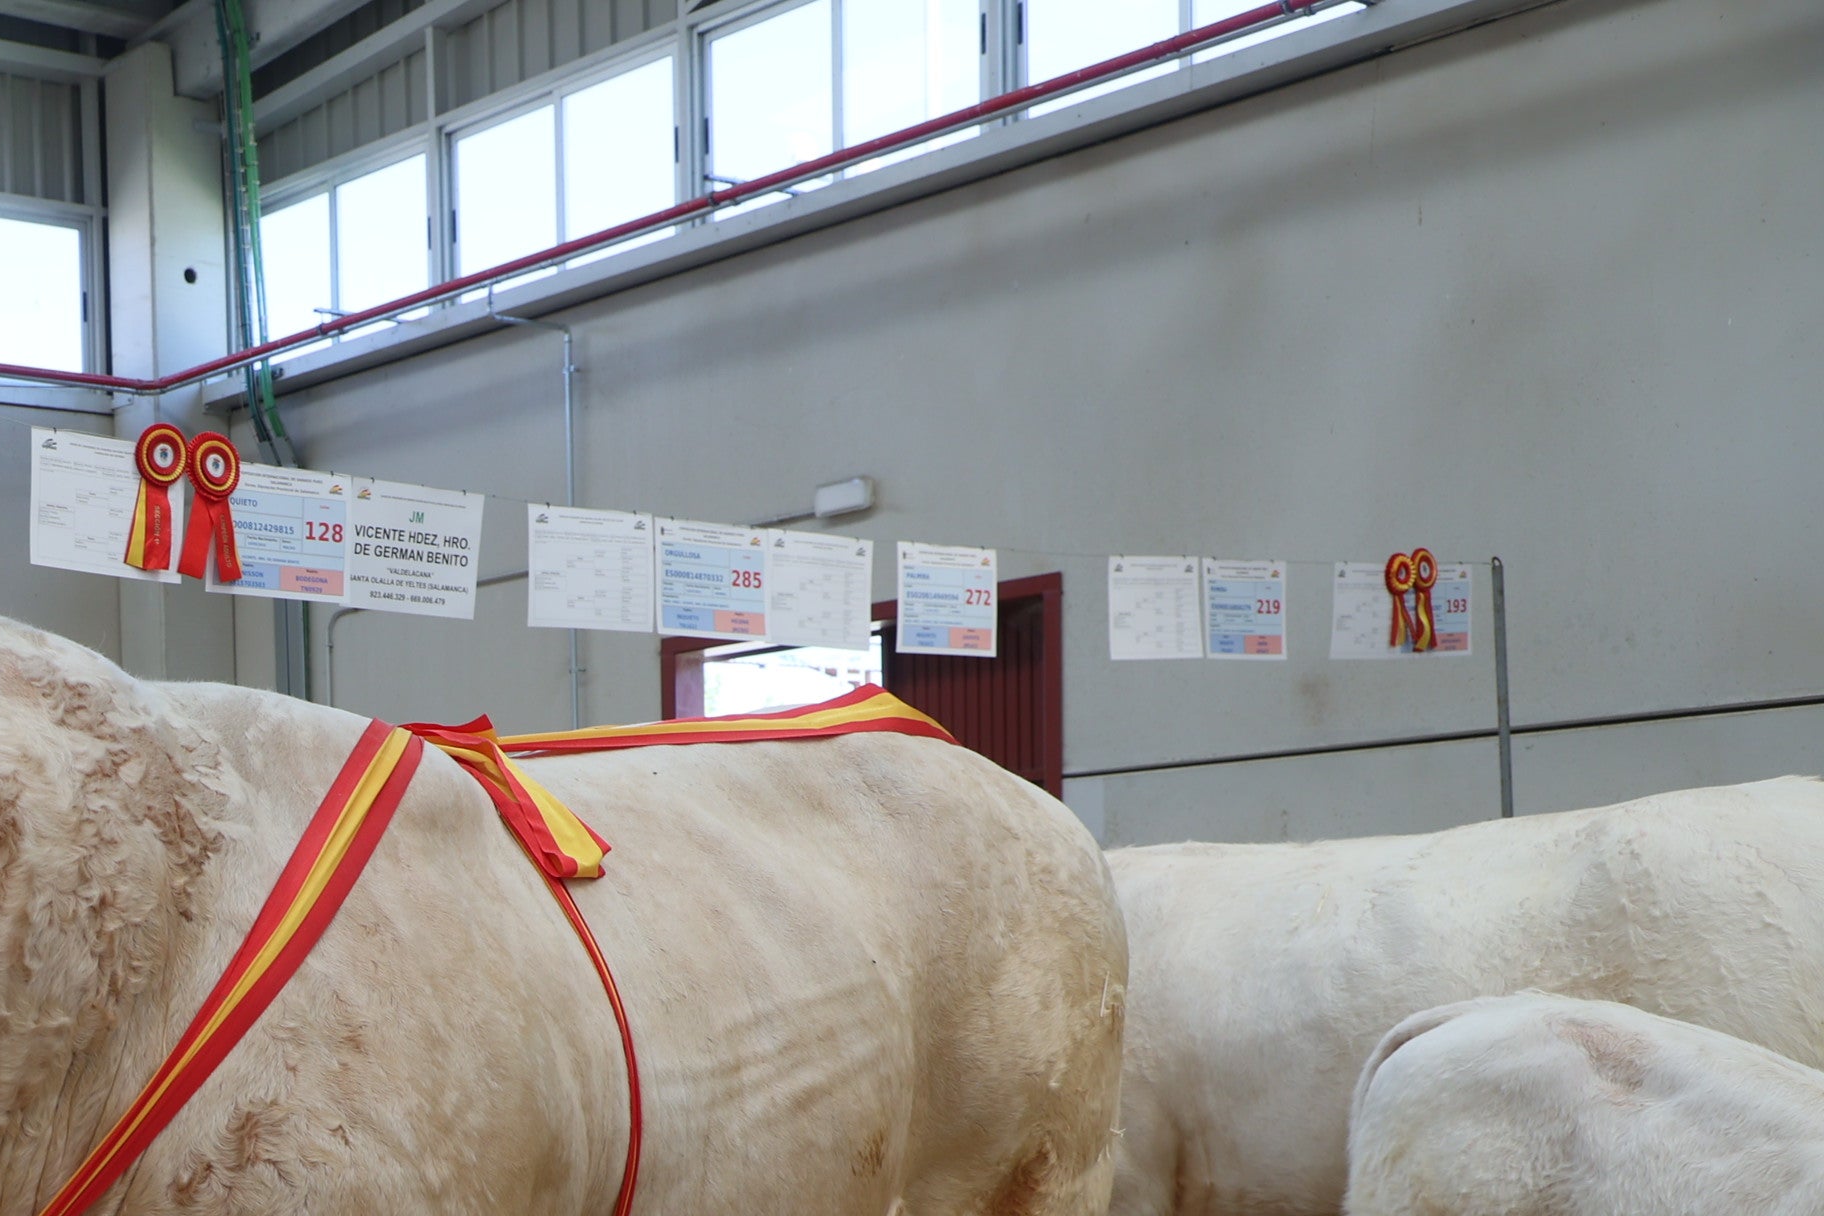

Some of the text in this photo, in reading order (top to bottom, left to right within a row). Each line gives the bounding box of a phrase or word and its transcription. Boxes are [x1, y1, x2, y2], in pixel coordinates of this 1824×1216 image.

[409, 510, 425, 524] JM
[305, 521, 344, 544] 128
[354, 524, 471, 551] VICENTE HDEZ, HRO.
[354, 542, 469, 567] DE GERMAN BENITO
[731, 569, 762, 589] 285
[965, 588, 991, 606] 272
[1446, 598, 1468, 614] 193
[1257, 599, 1281, 615] 219
